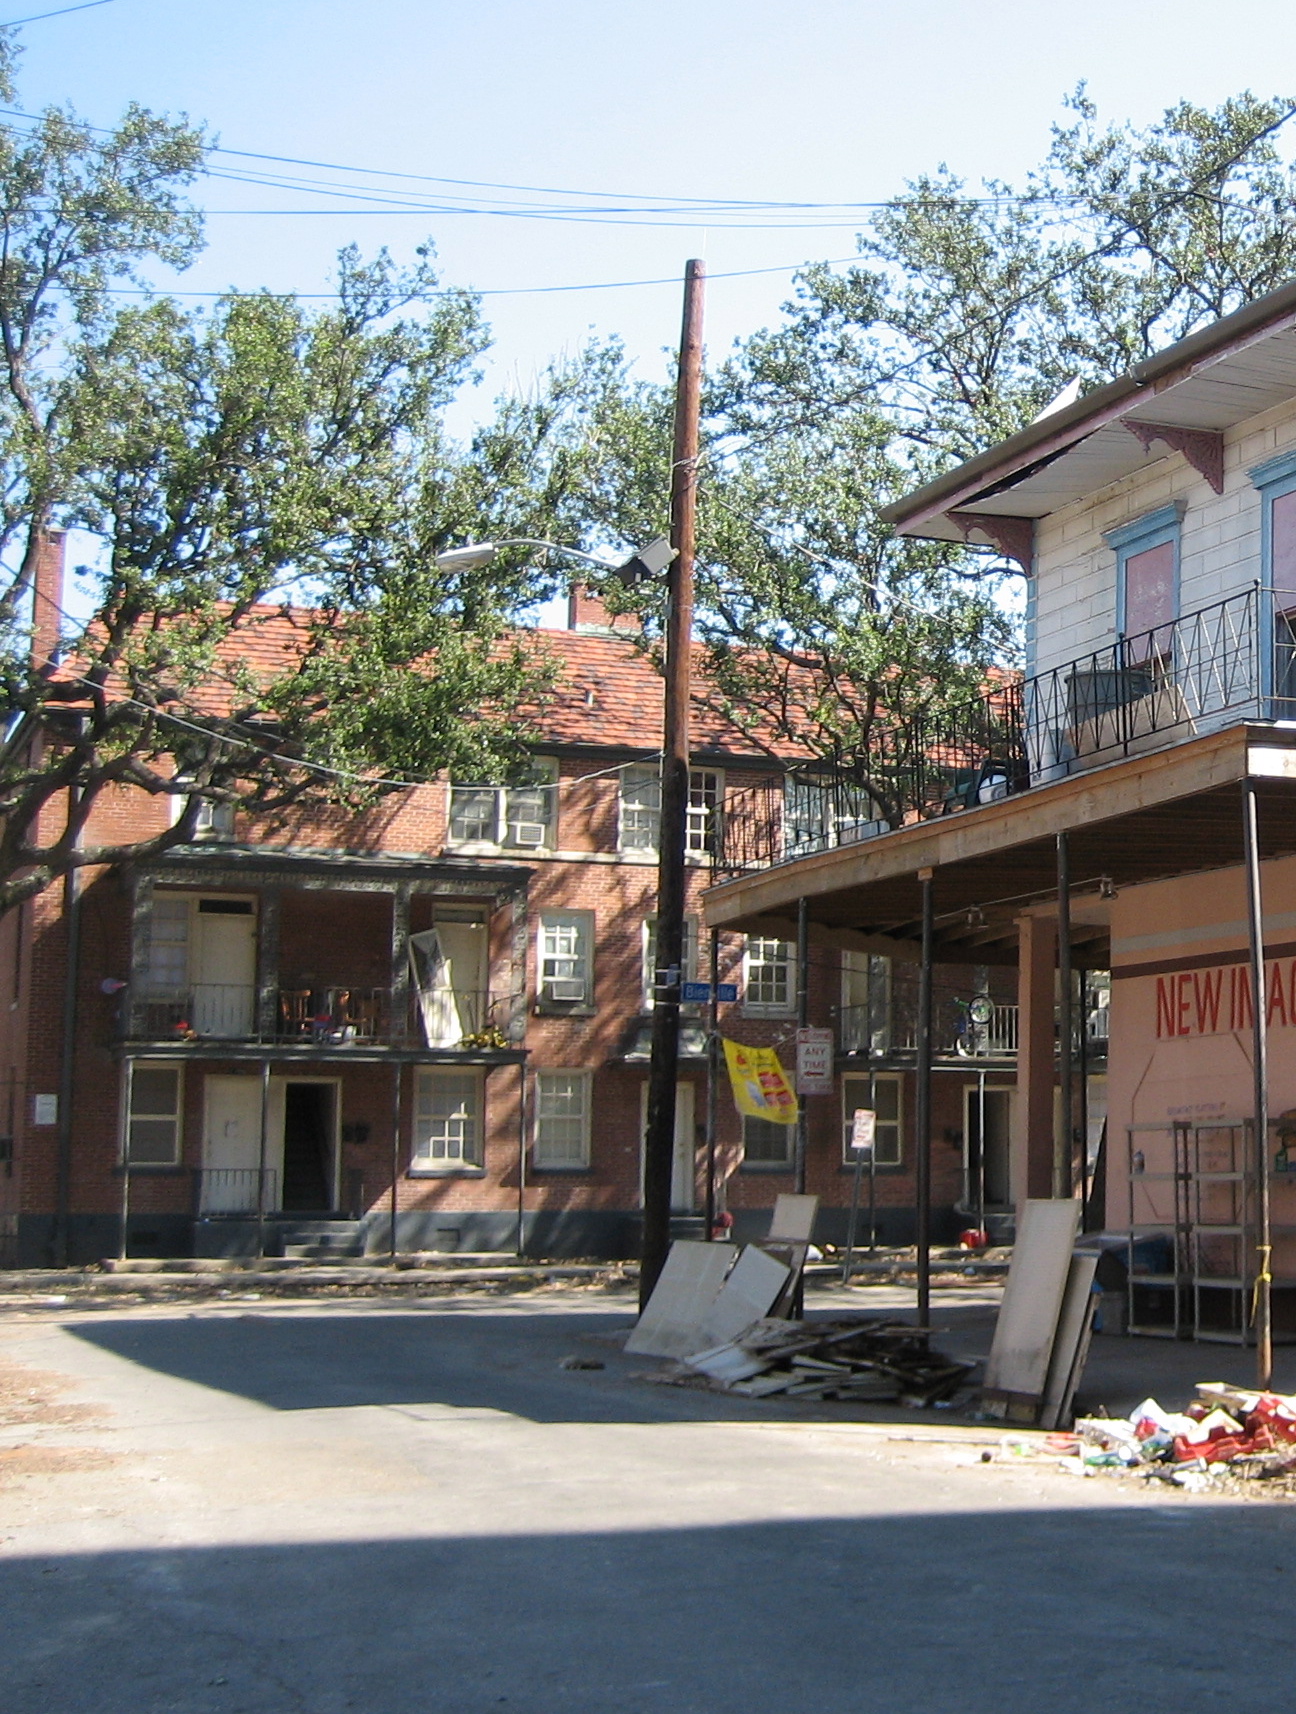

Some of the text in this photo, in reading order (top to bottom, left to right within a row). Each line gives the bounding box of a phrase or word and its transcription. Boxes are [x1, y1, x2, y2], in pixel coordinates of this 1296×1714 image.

[686, 985, 734, 999] Bienille
[1156, 968, 1223, 1038] NEW
[805, 1048, 825, 1056] ANY
[804, 1060, 826, 1069] TIME
